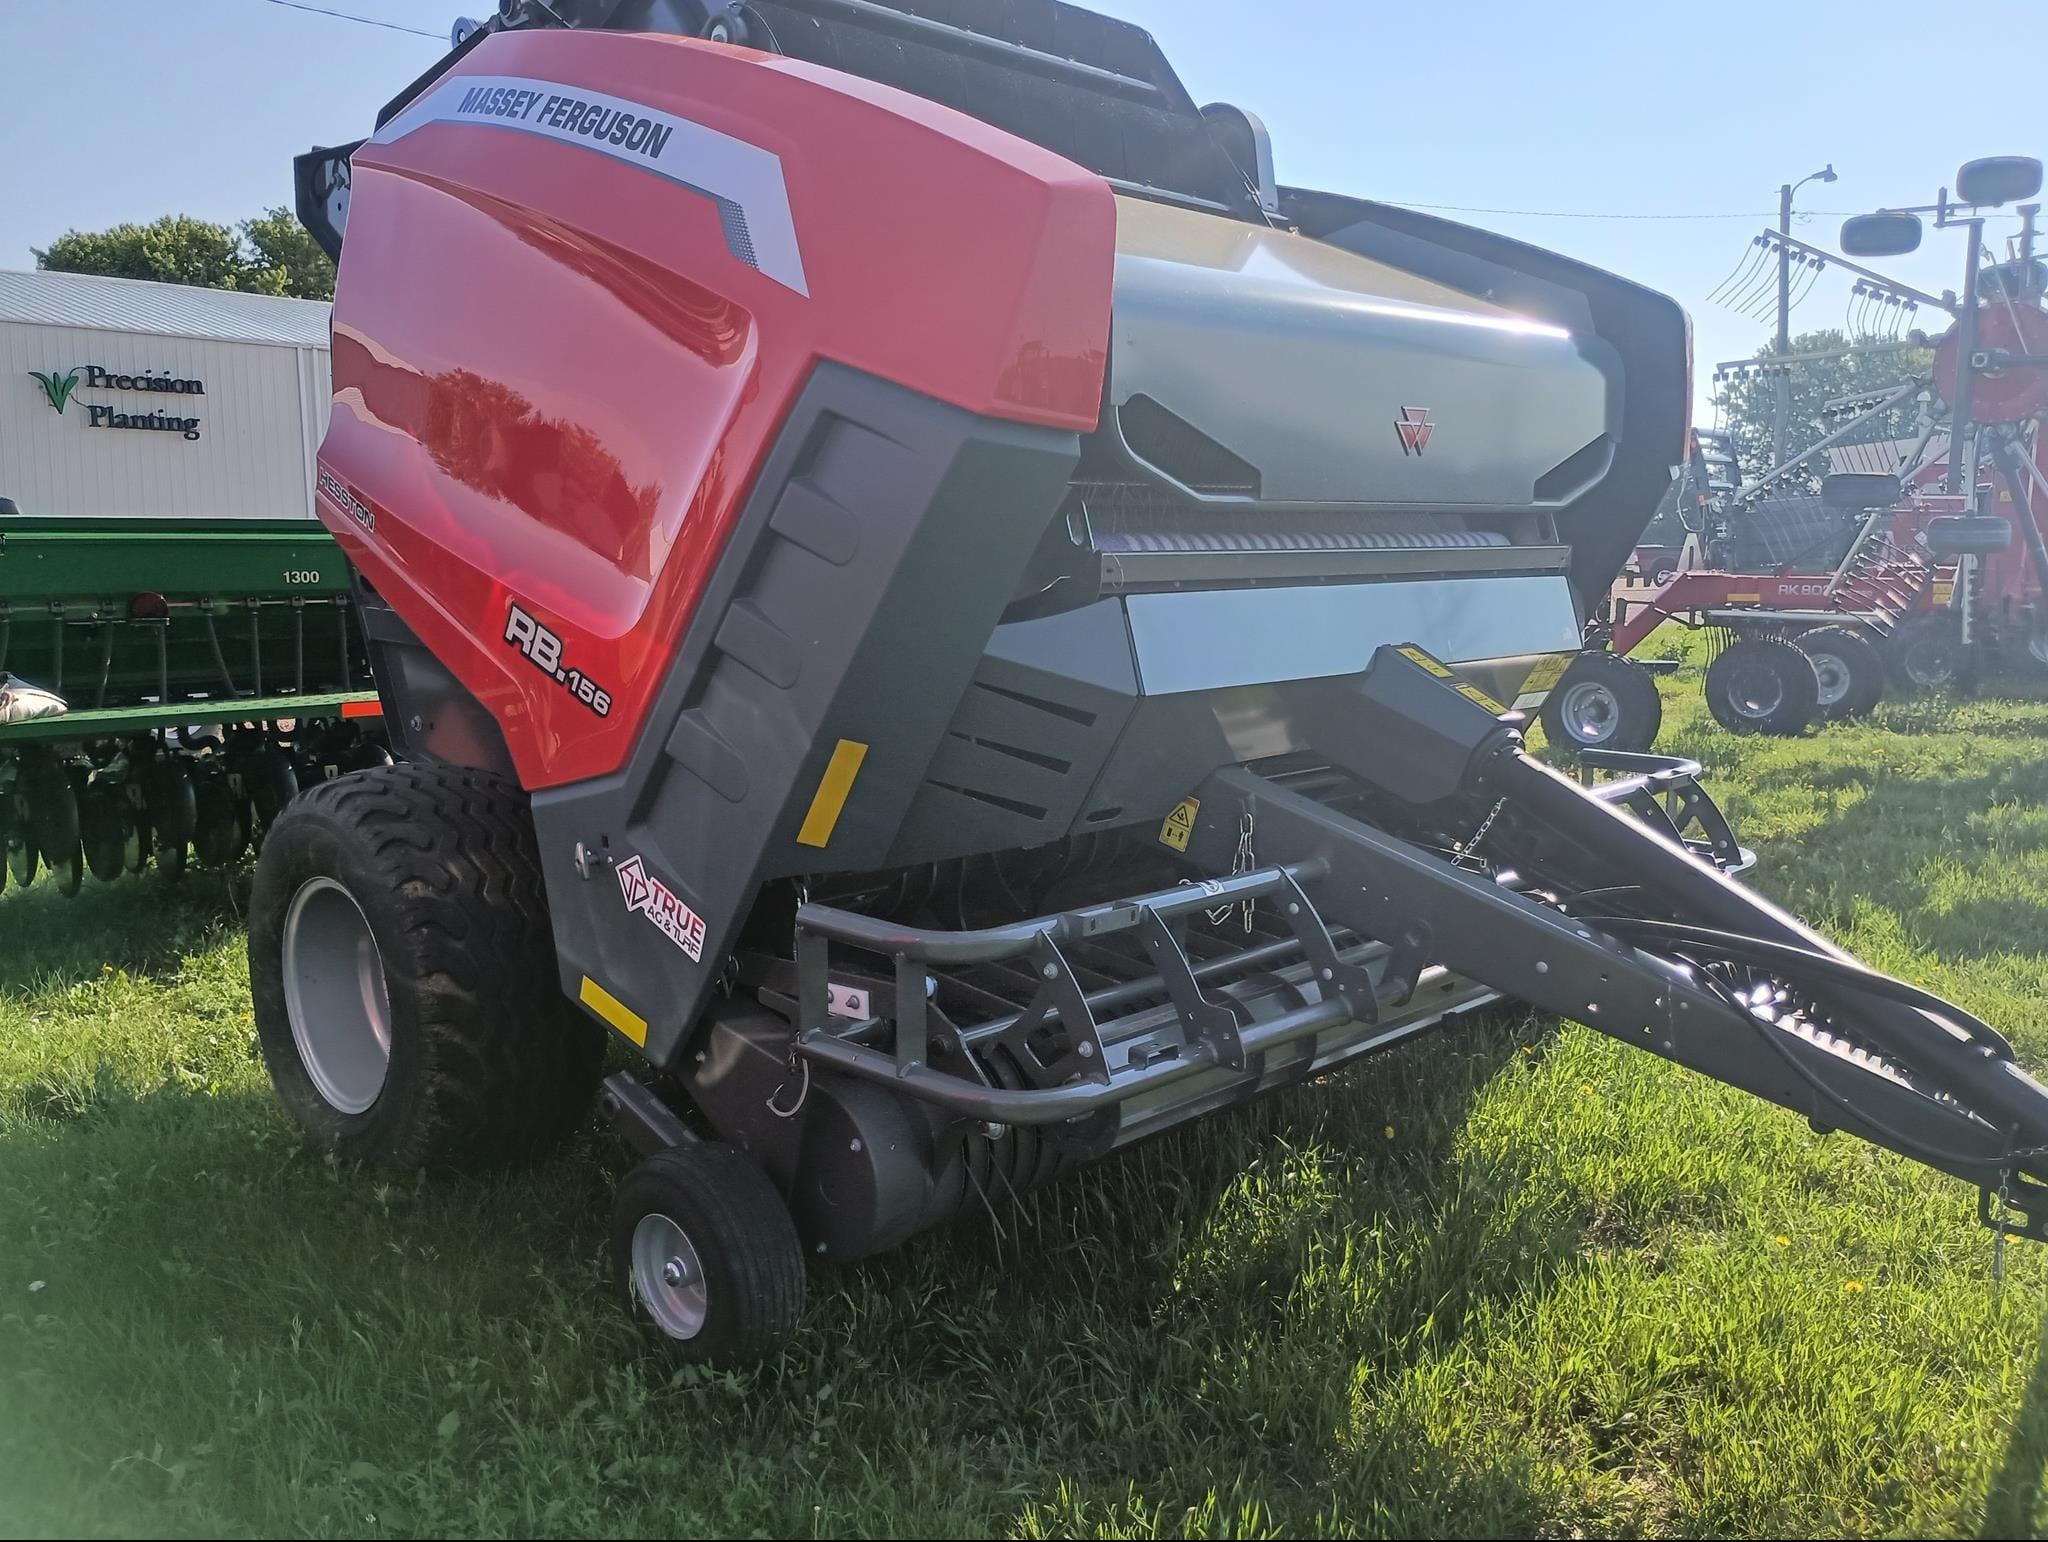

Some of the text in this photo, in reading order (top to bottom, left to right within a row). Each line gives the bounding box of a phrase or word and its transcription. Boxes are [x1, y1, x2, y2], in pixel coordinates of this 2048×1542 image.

[457, 87, 674, 159] MASSEY FERGUSON
[86, 365, 205, 395] Precision
[87, 404, 201, 441] Planting
[320, 466, 375, 533] HESSTON
[282, 570, 320, 584] 1300
[1778, 584, 1799, 596] RK
[647, 905, 700, 955] AG & TURF
[651, 880, 704, 945] TRUE
